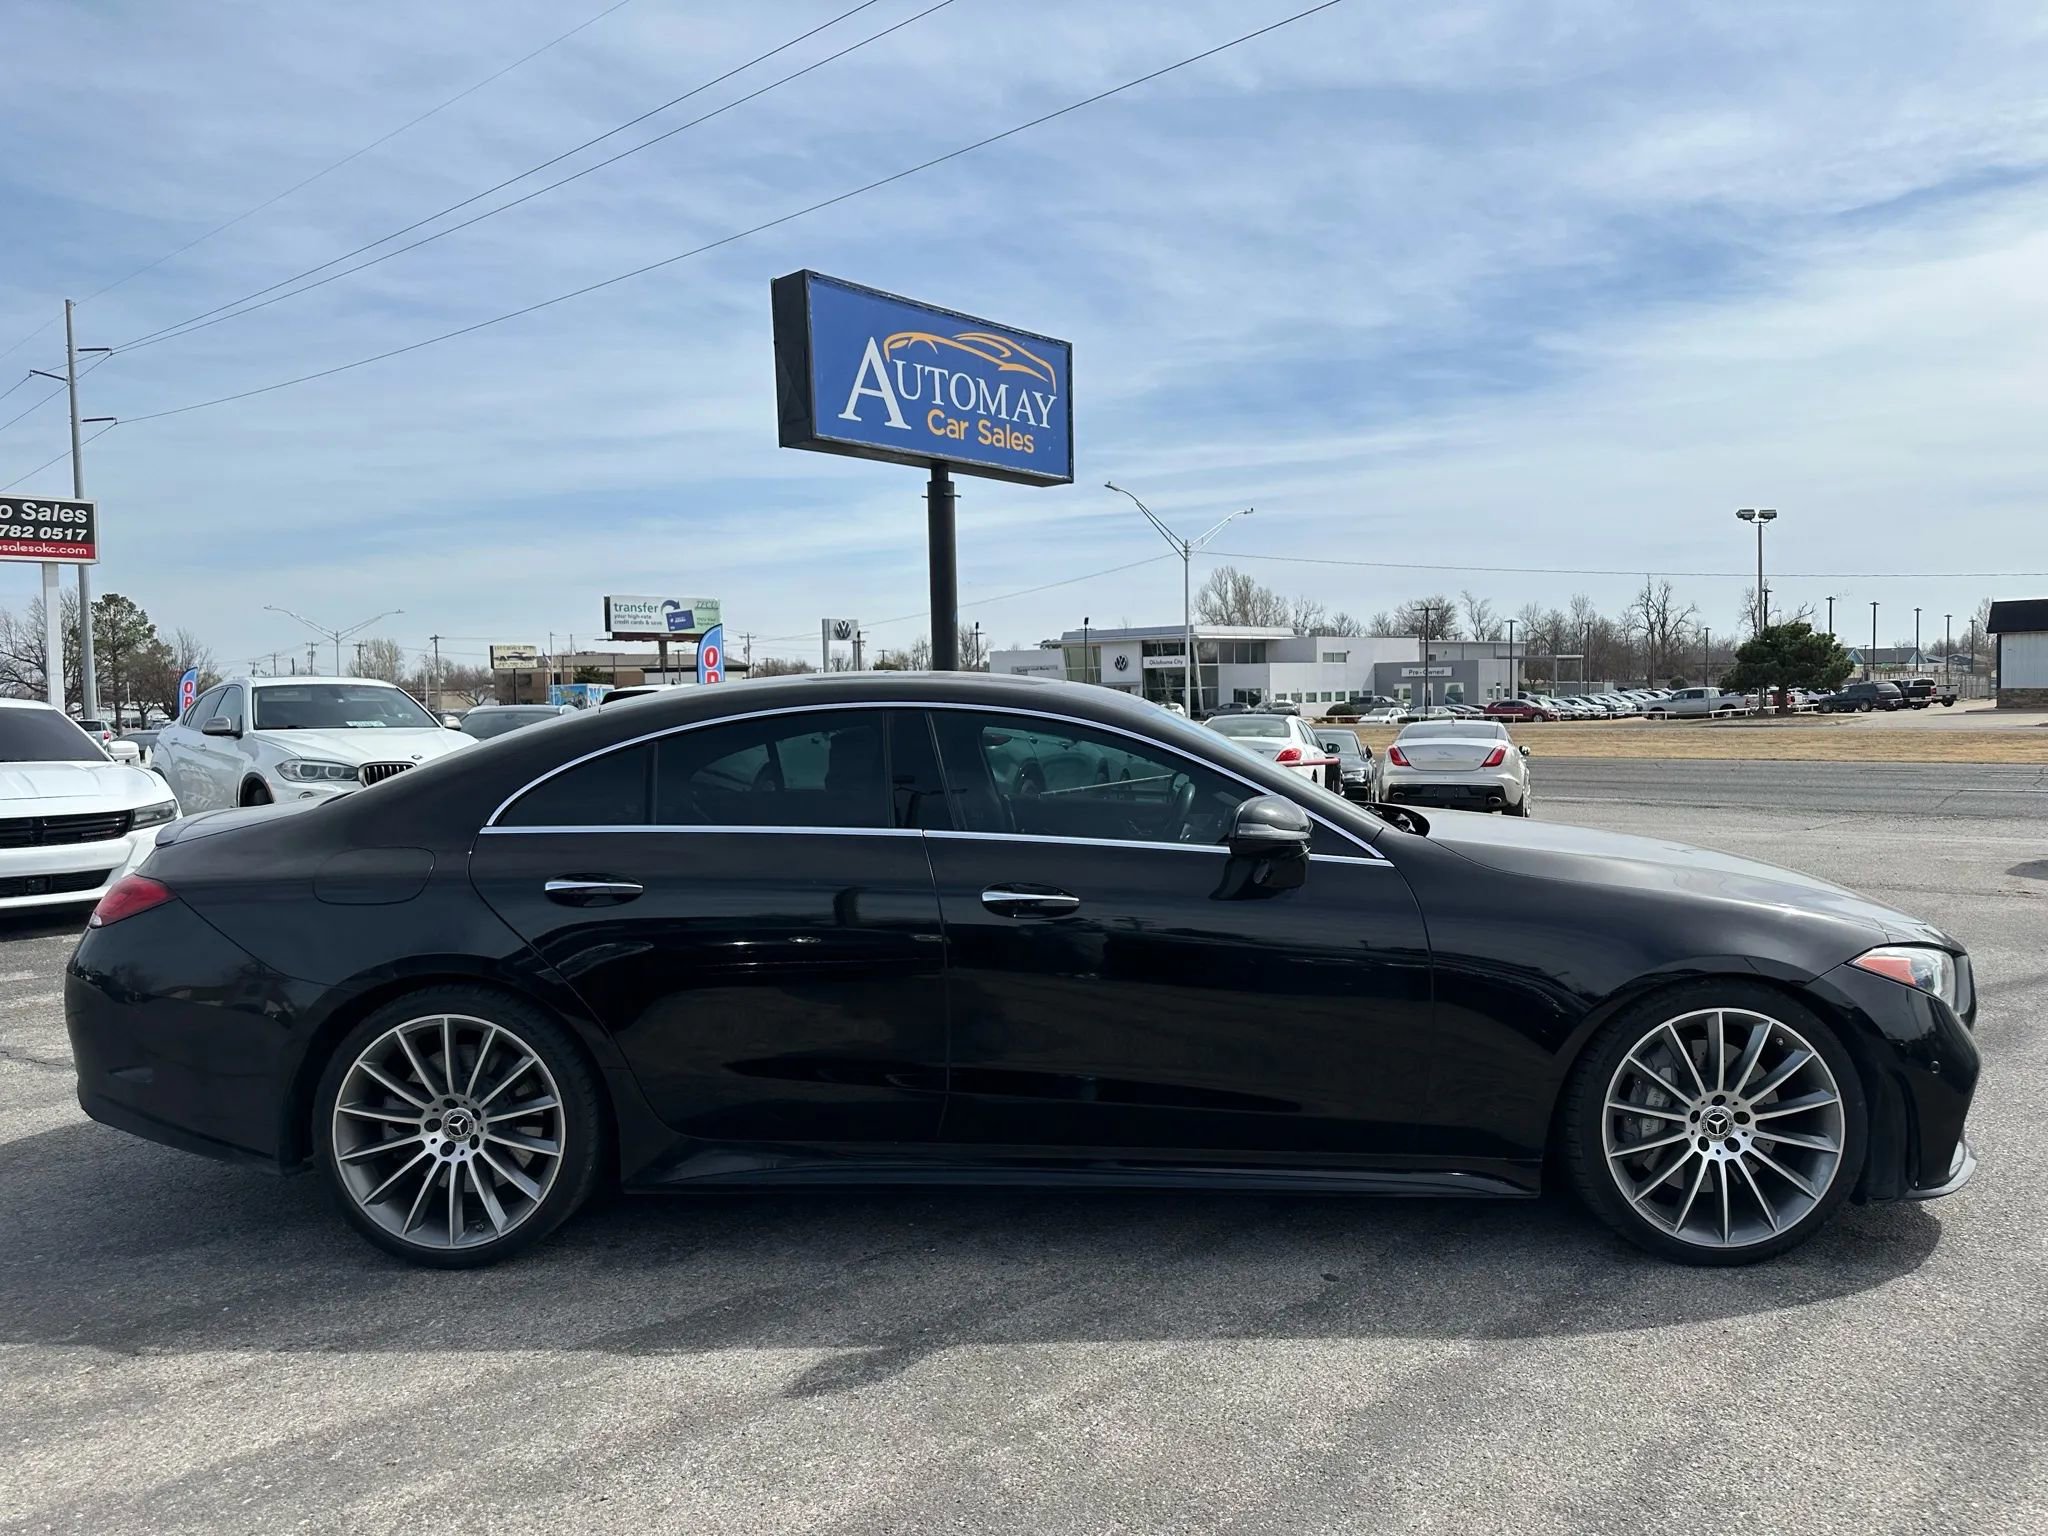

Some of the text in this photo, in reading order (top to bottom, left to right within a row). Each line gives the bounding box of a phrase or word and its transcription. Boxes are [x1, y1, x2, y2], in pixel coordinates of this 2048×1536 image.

[838, 336, 1057, 430] AUTOMAY
[927, 408, 1035, 454] Car Sales
[21, 501, 88, 524] Sales
[0, 524, 88, 541] 782 0517
[0, 541, 87, 555] salesokc.com
[613, 602, 659, 613] transfer
